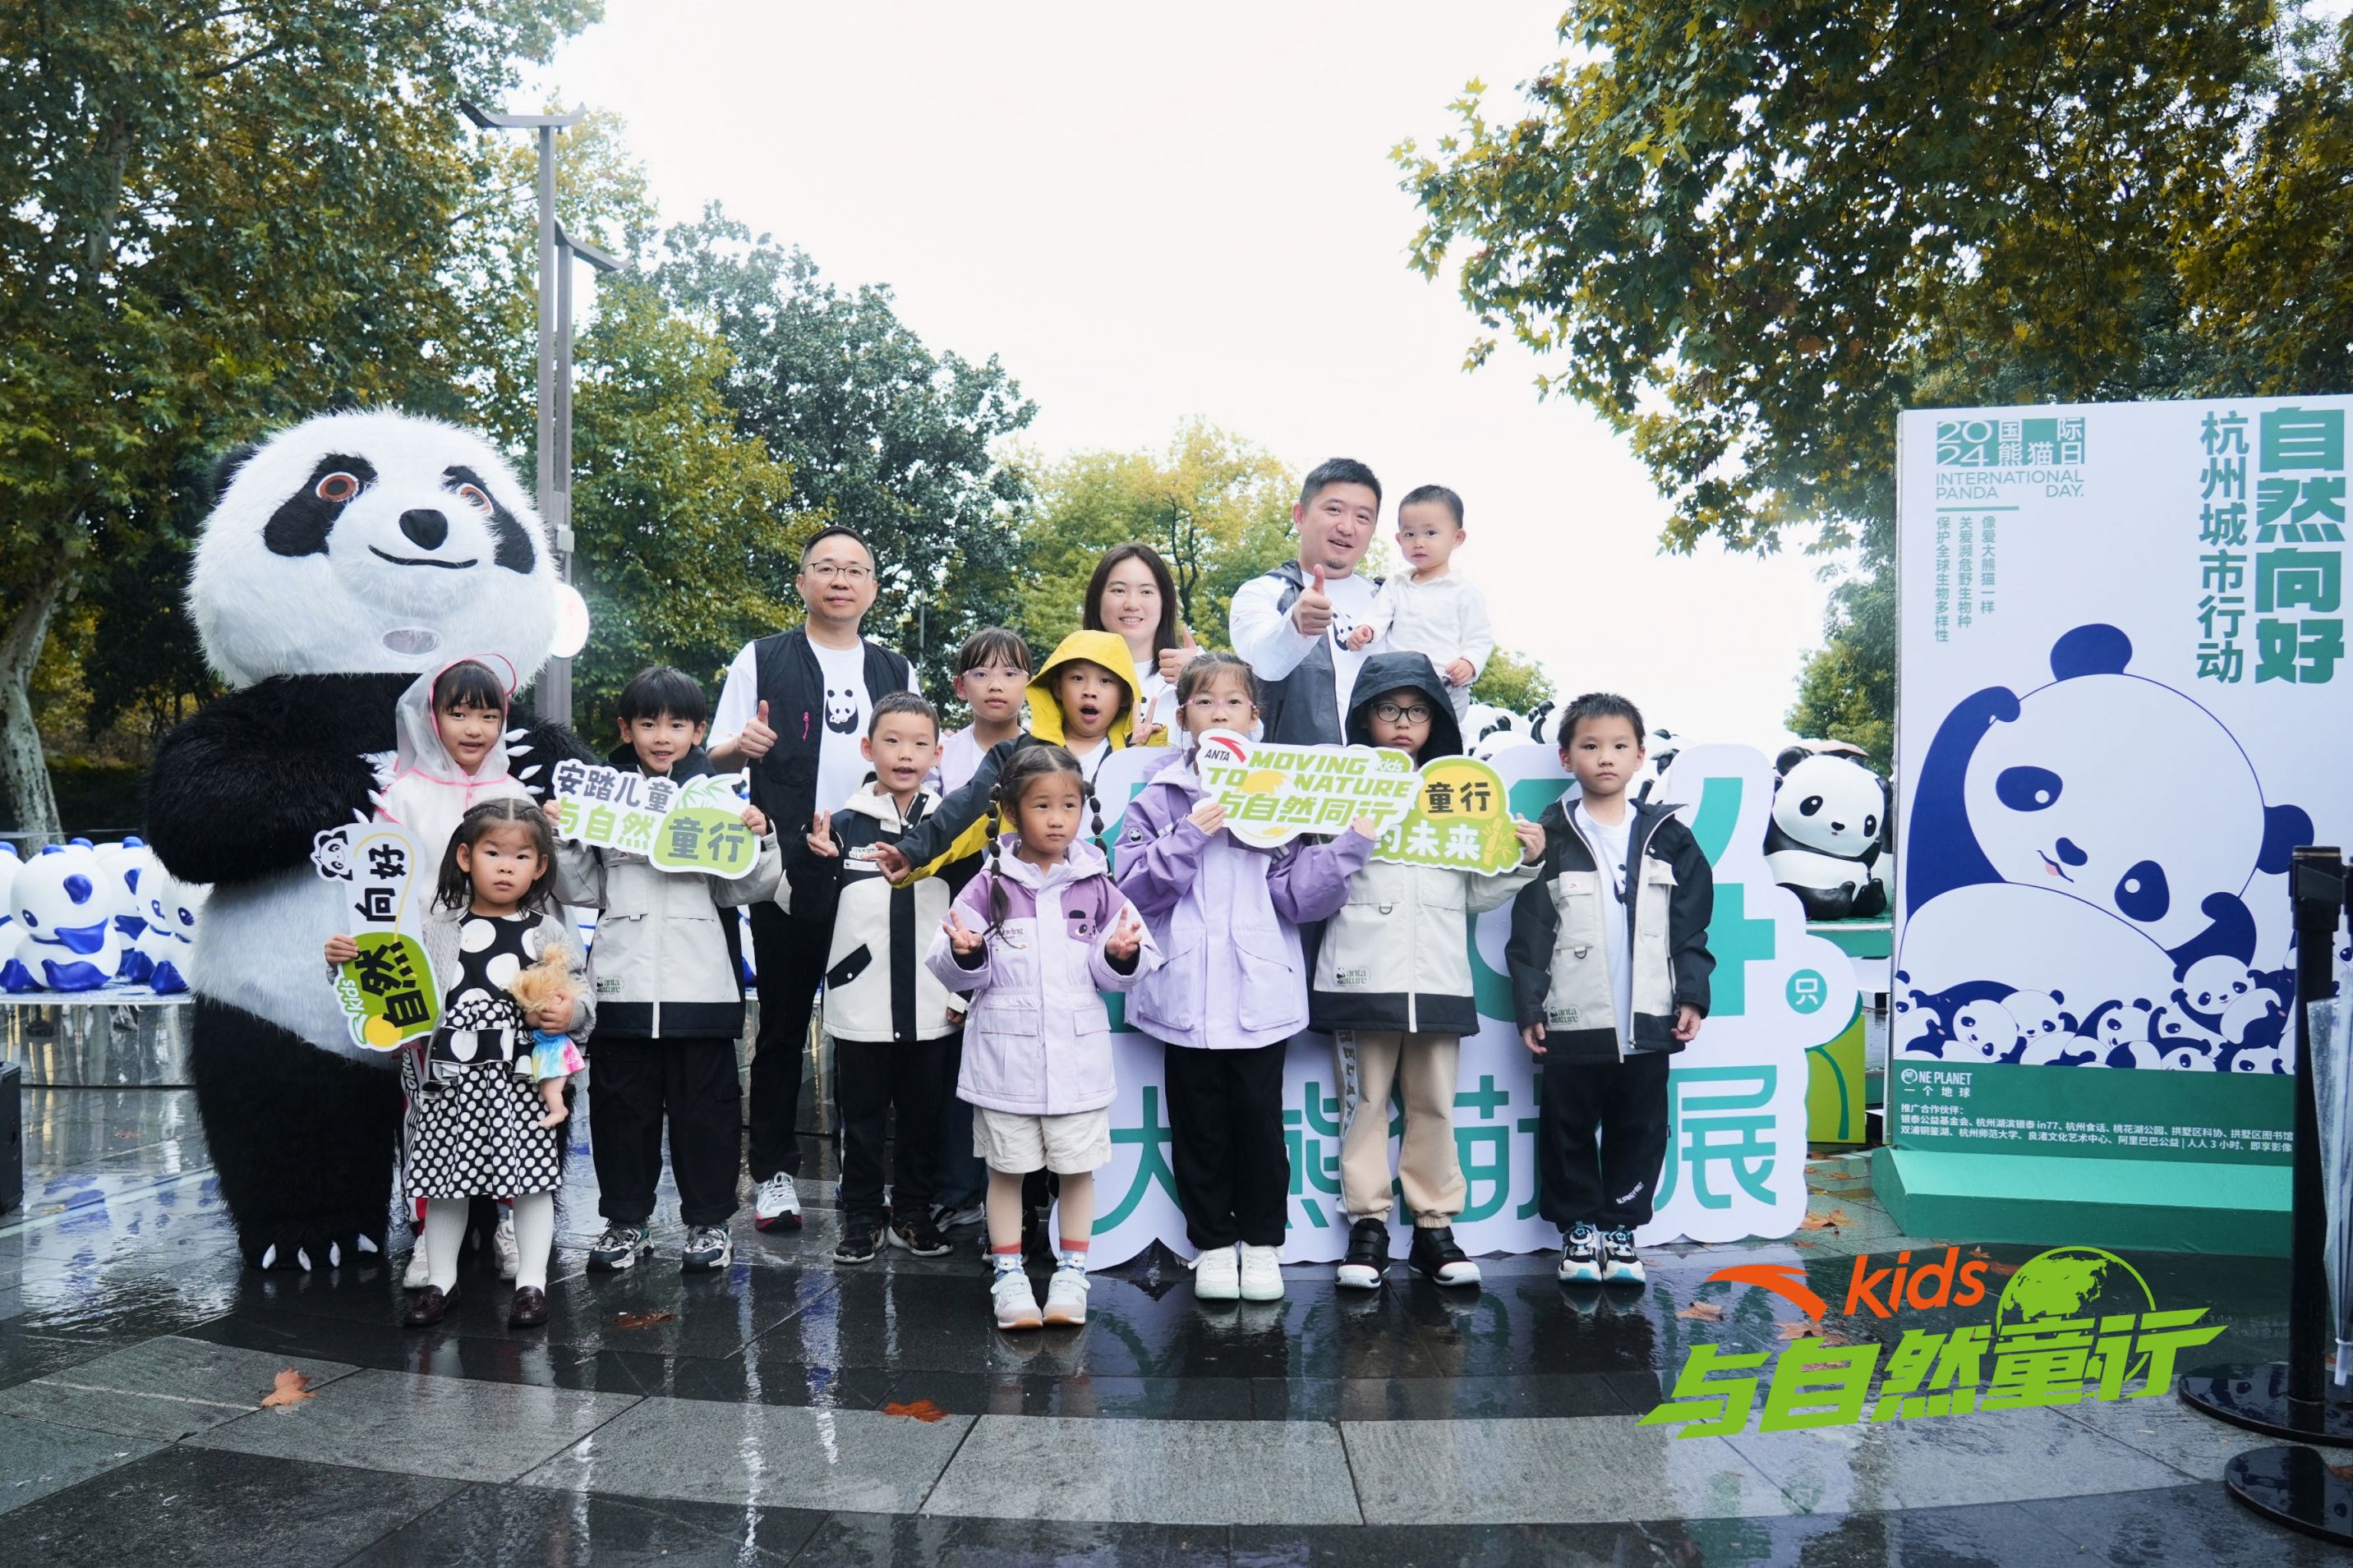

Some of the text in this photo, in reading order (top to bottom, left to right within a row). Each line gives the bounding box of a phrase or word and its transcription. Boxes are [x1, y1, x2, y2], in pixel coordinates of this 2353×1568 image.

[1936, 470, 2084, 485] INTERNATIONAL
[1936, 485, 2084, 500] PANDA DAY.
[2196, 410, 2249, 683] 杭州城市行动
[2254, 407, 2346, 684] 自然向好
[1934, 517, 1950, 642] 保护全球生物多样性
[1957, 516, 1973, 628] 关爱濒危野生物种
[1980, 516, 1996, 614] 像爱大熊猫一样
[1204, 748, 1231, 762] ANTA
[1248, 750, 1370, 775] MOVING
[1375, 757, 1404, 772] kids
[558, 764, 673, 814] 安踏儿童
[1207, 766, 1414, 798] TO NATURE
[1425, 782, 1491, 814] 童行
[559, 797, 656, 850] 与自然
[1218, 791, 1399, 827] 与自然同行
[668, 816, 745, 862] 童行
[338, 978, 365, 1012] kids
[1795, 977, 1819, 1005] 只
[1934, 1070, 1973, 1086] PLANET
